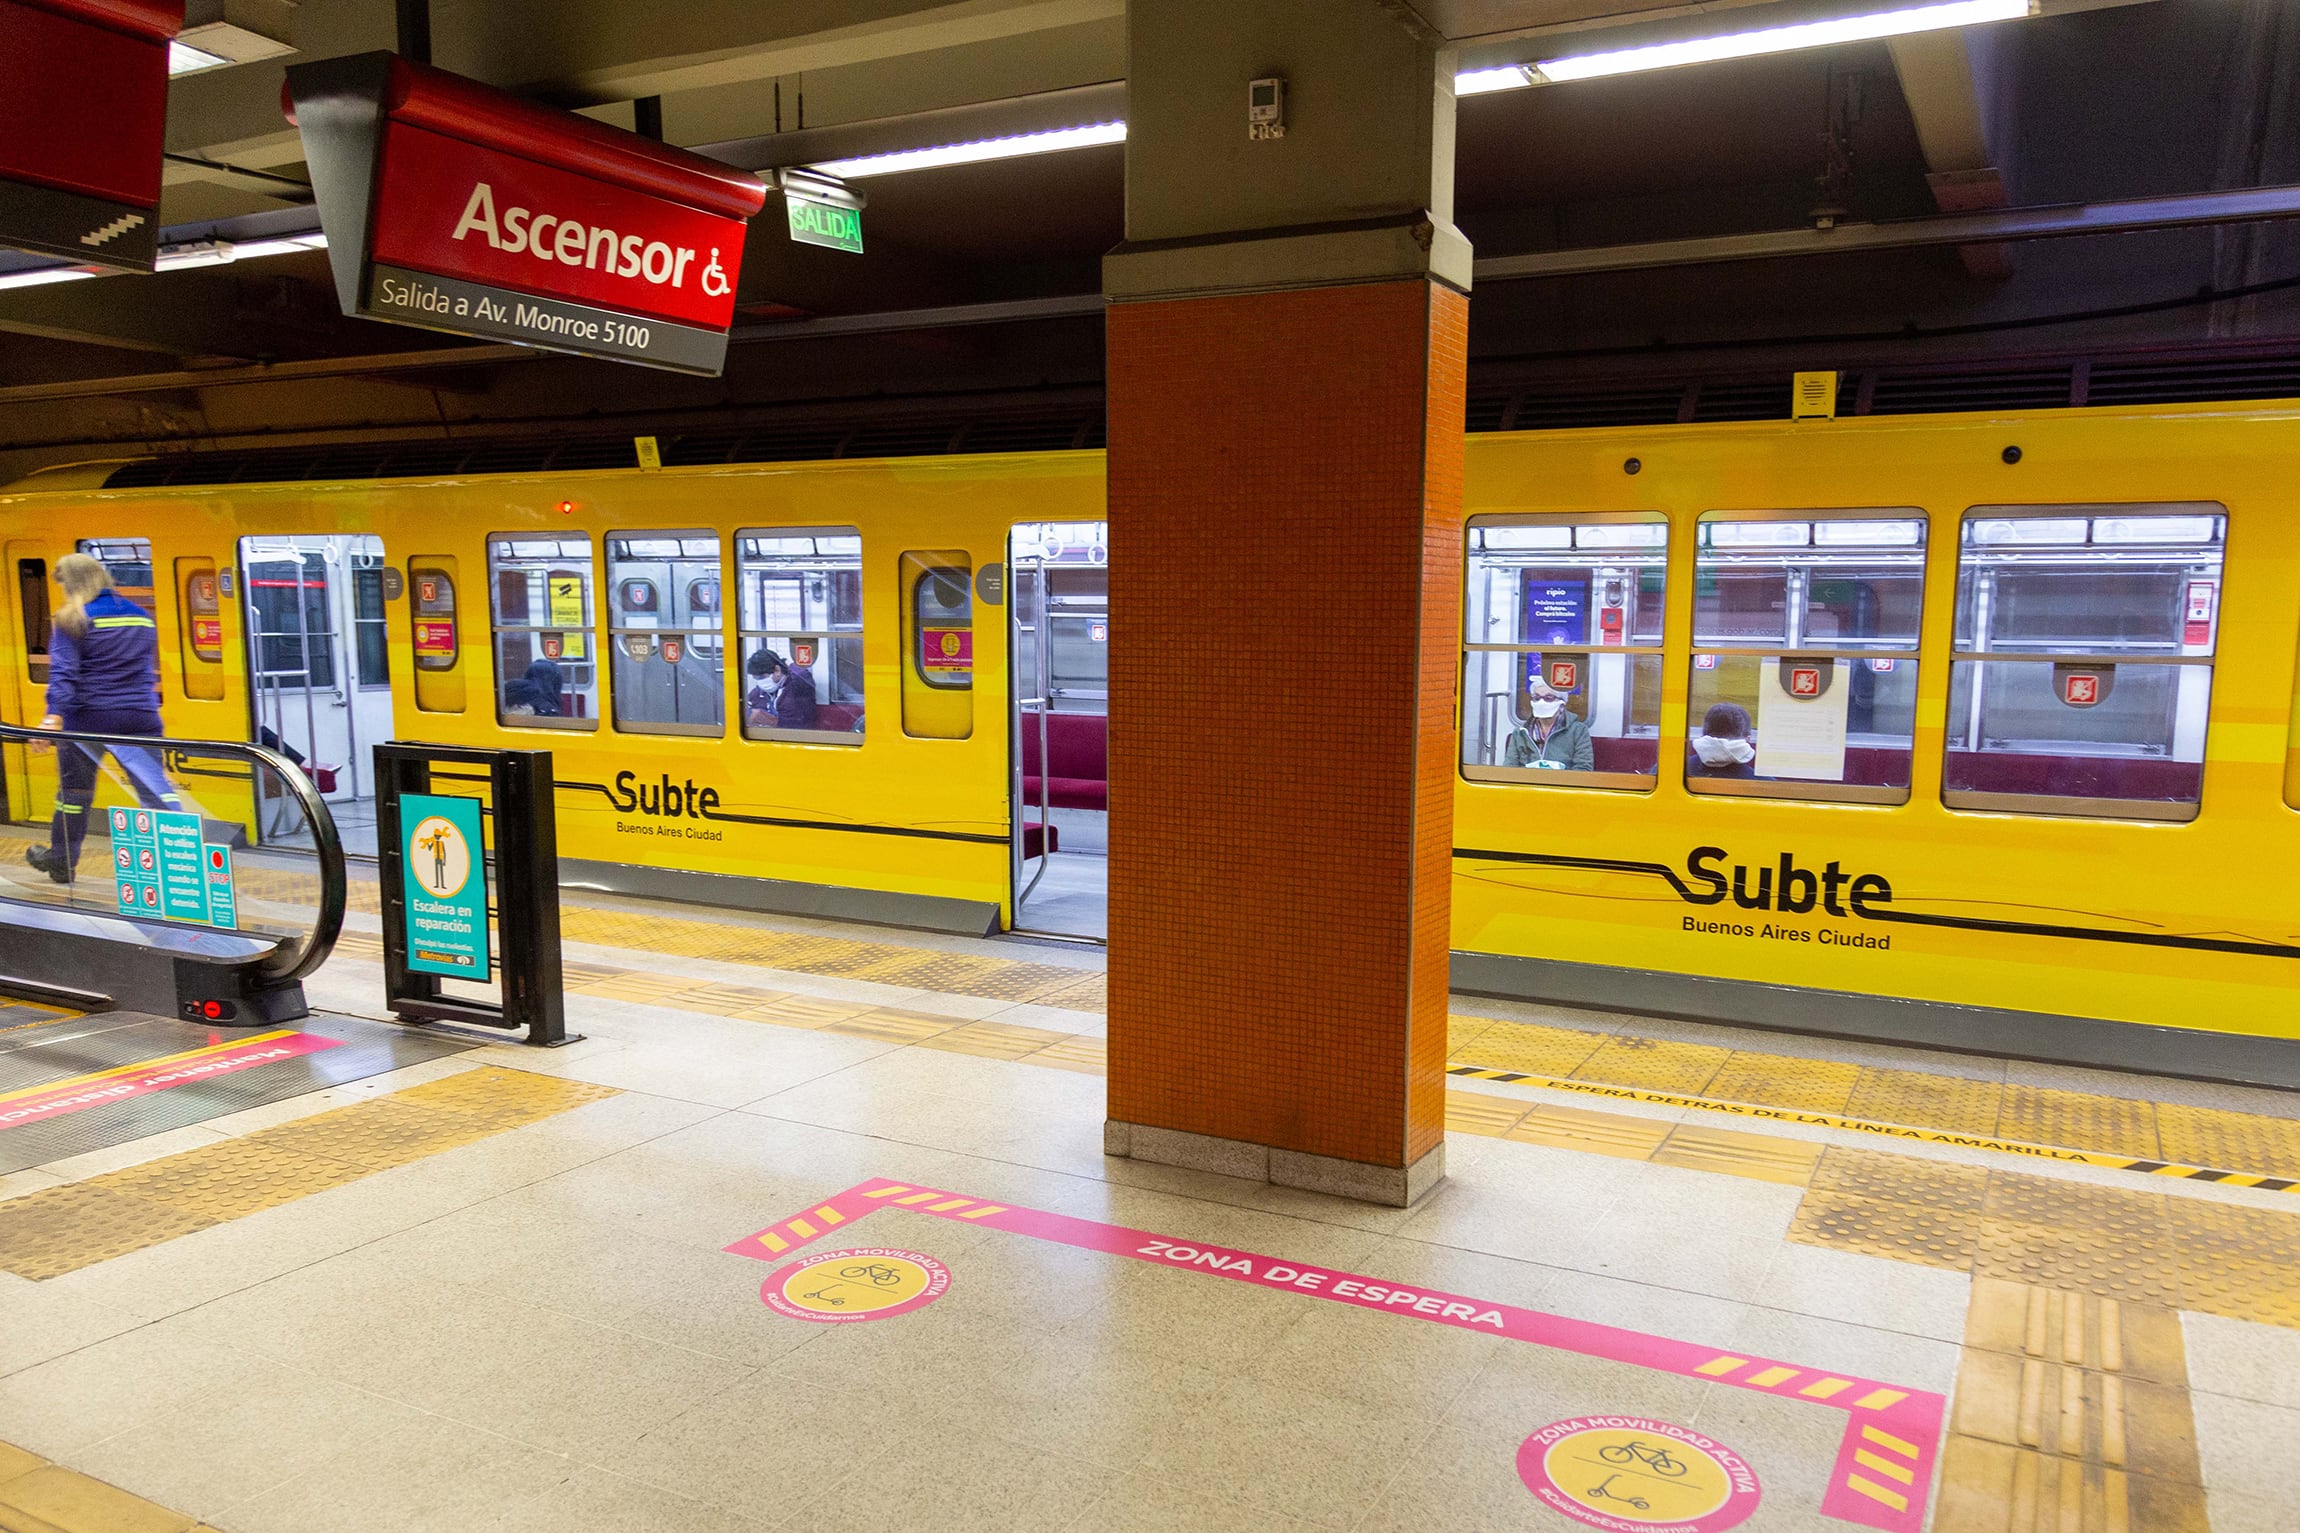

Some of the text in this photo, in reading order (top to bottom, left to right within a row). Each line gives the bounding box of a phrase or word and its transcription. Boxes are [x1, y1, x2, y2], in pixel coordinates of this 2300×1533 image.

[452, 182, 695, 288] Ascensor
[792, 205, 860, 242] SALIDA
[380, 278, 650, 349] Salida a Av. Monroe 5100
[616, 770, 720, 820] Subte
[617, 821, 722, 841] Buenos Aires Ciudad
[209, 872, 230, 885] STOP
[1684, 846, 1892, 919] Subte
[414, 899, 472, 917] Escalera en
[416, 918, 471, 933] reparación
[1682, 916, 1890, 950] Buenos Aires Ciudad
[145, 1048, 291, 1087] Mantener
[1547, 1081, 2089, 1163] ESPERA DETRÁS DE LA LÍNEA AMARILLA
[797, 1248, 949, 1297] ZONA MOVILIDAD ACTIVA
[1136, 1240, 1505, 1328] ZONA DE ESPERA
[1533, 1417, 1756, 1494] ZONA MOVILIDAD ACTIVA
[1539, 1487, 1699, 1533] #CuidarteEsCuidarnos
